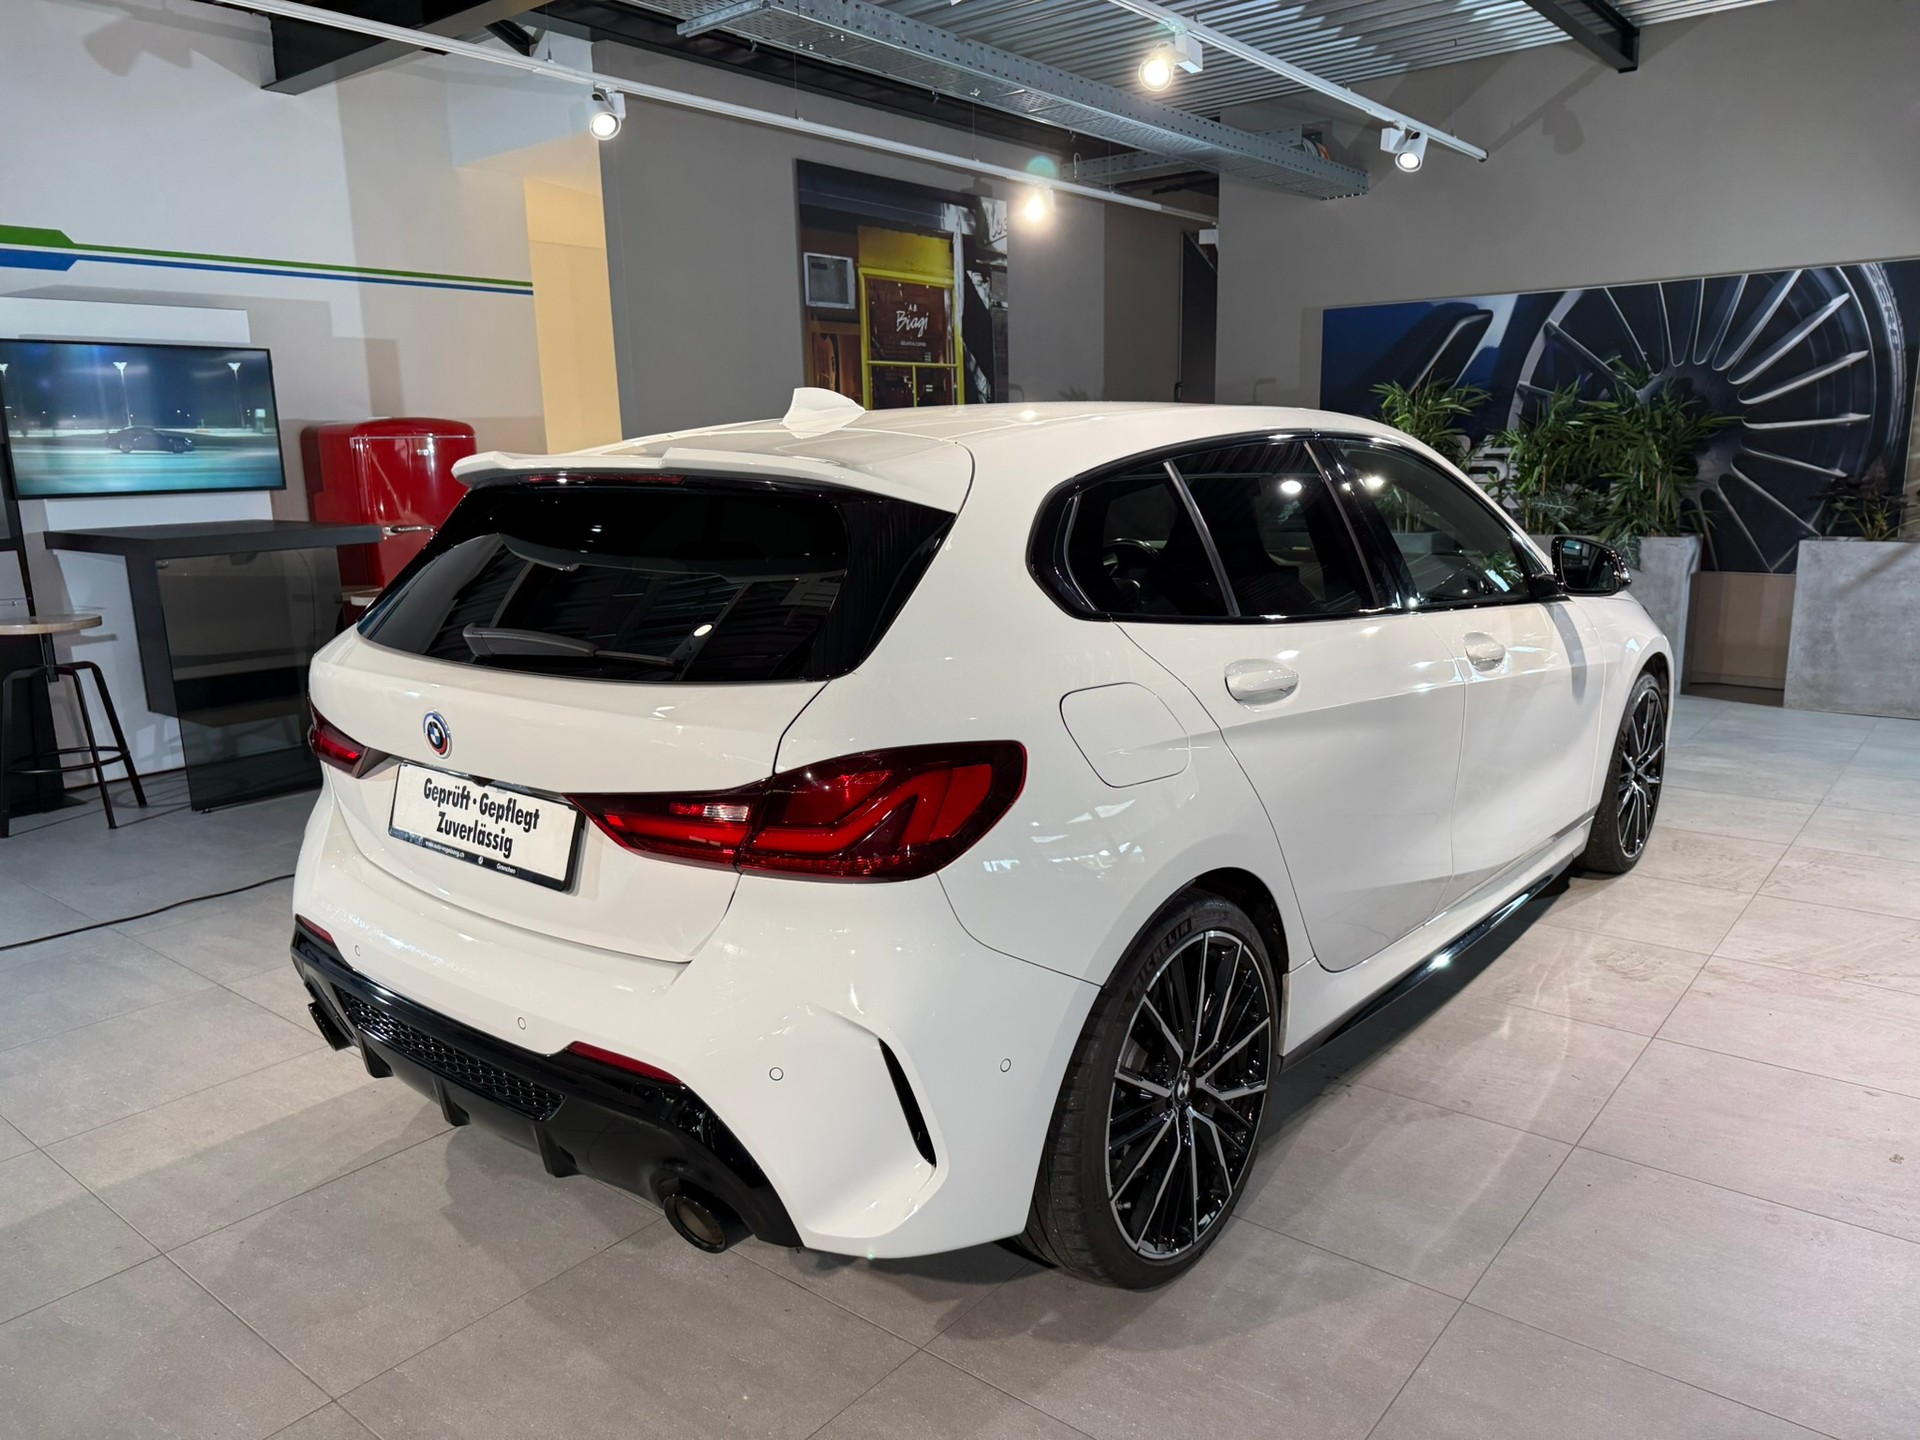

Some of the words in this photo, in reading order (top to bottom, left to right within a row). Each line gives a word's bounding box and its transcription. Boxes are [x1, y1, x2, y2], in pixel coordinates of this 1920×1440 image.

[896, 310, 929, 338] Biagi
[424, 777, 471, 810] Geprüft
[479, 792, 540, 833] Gepflegt
[436, 811, 513, 859] Zuverlässig
[1131, 918, 1192, 998] MICHELIN
